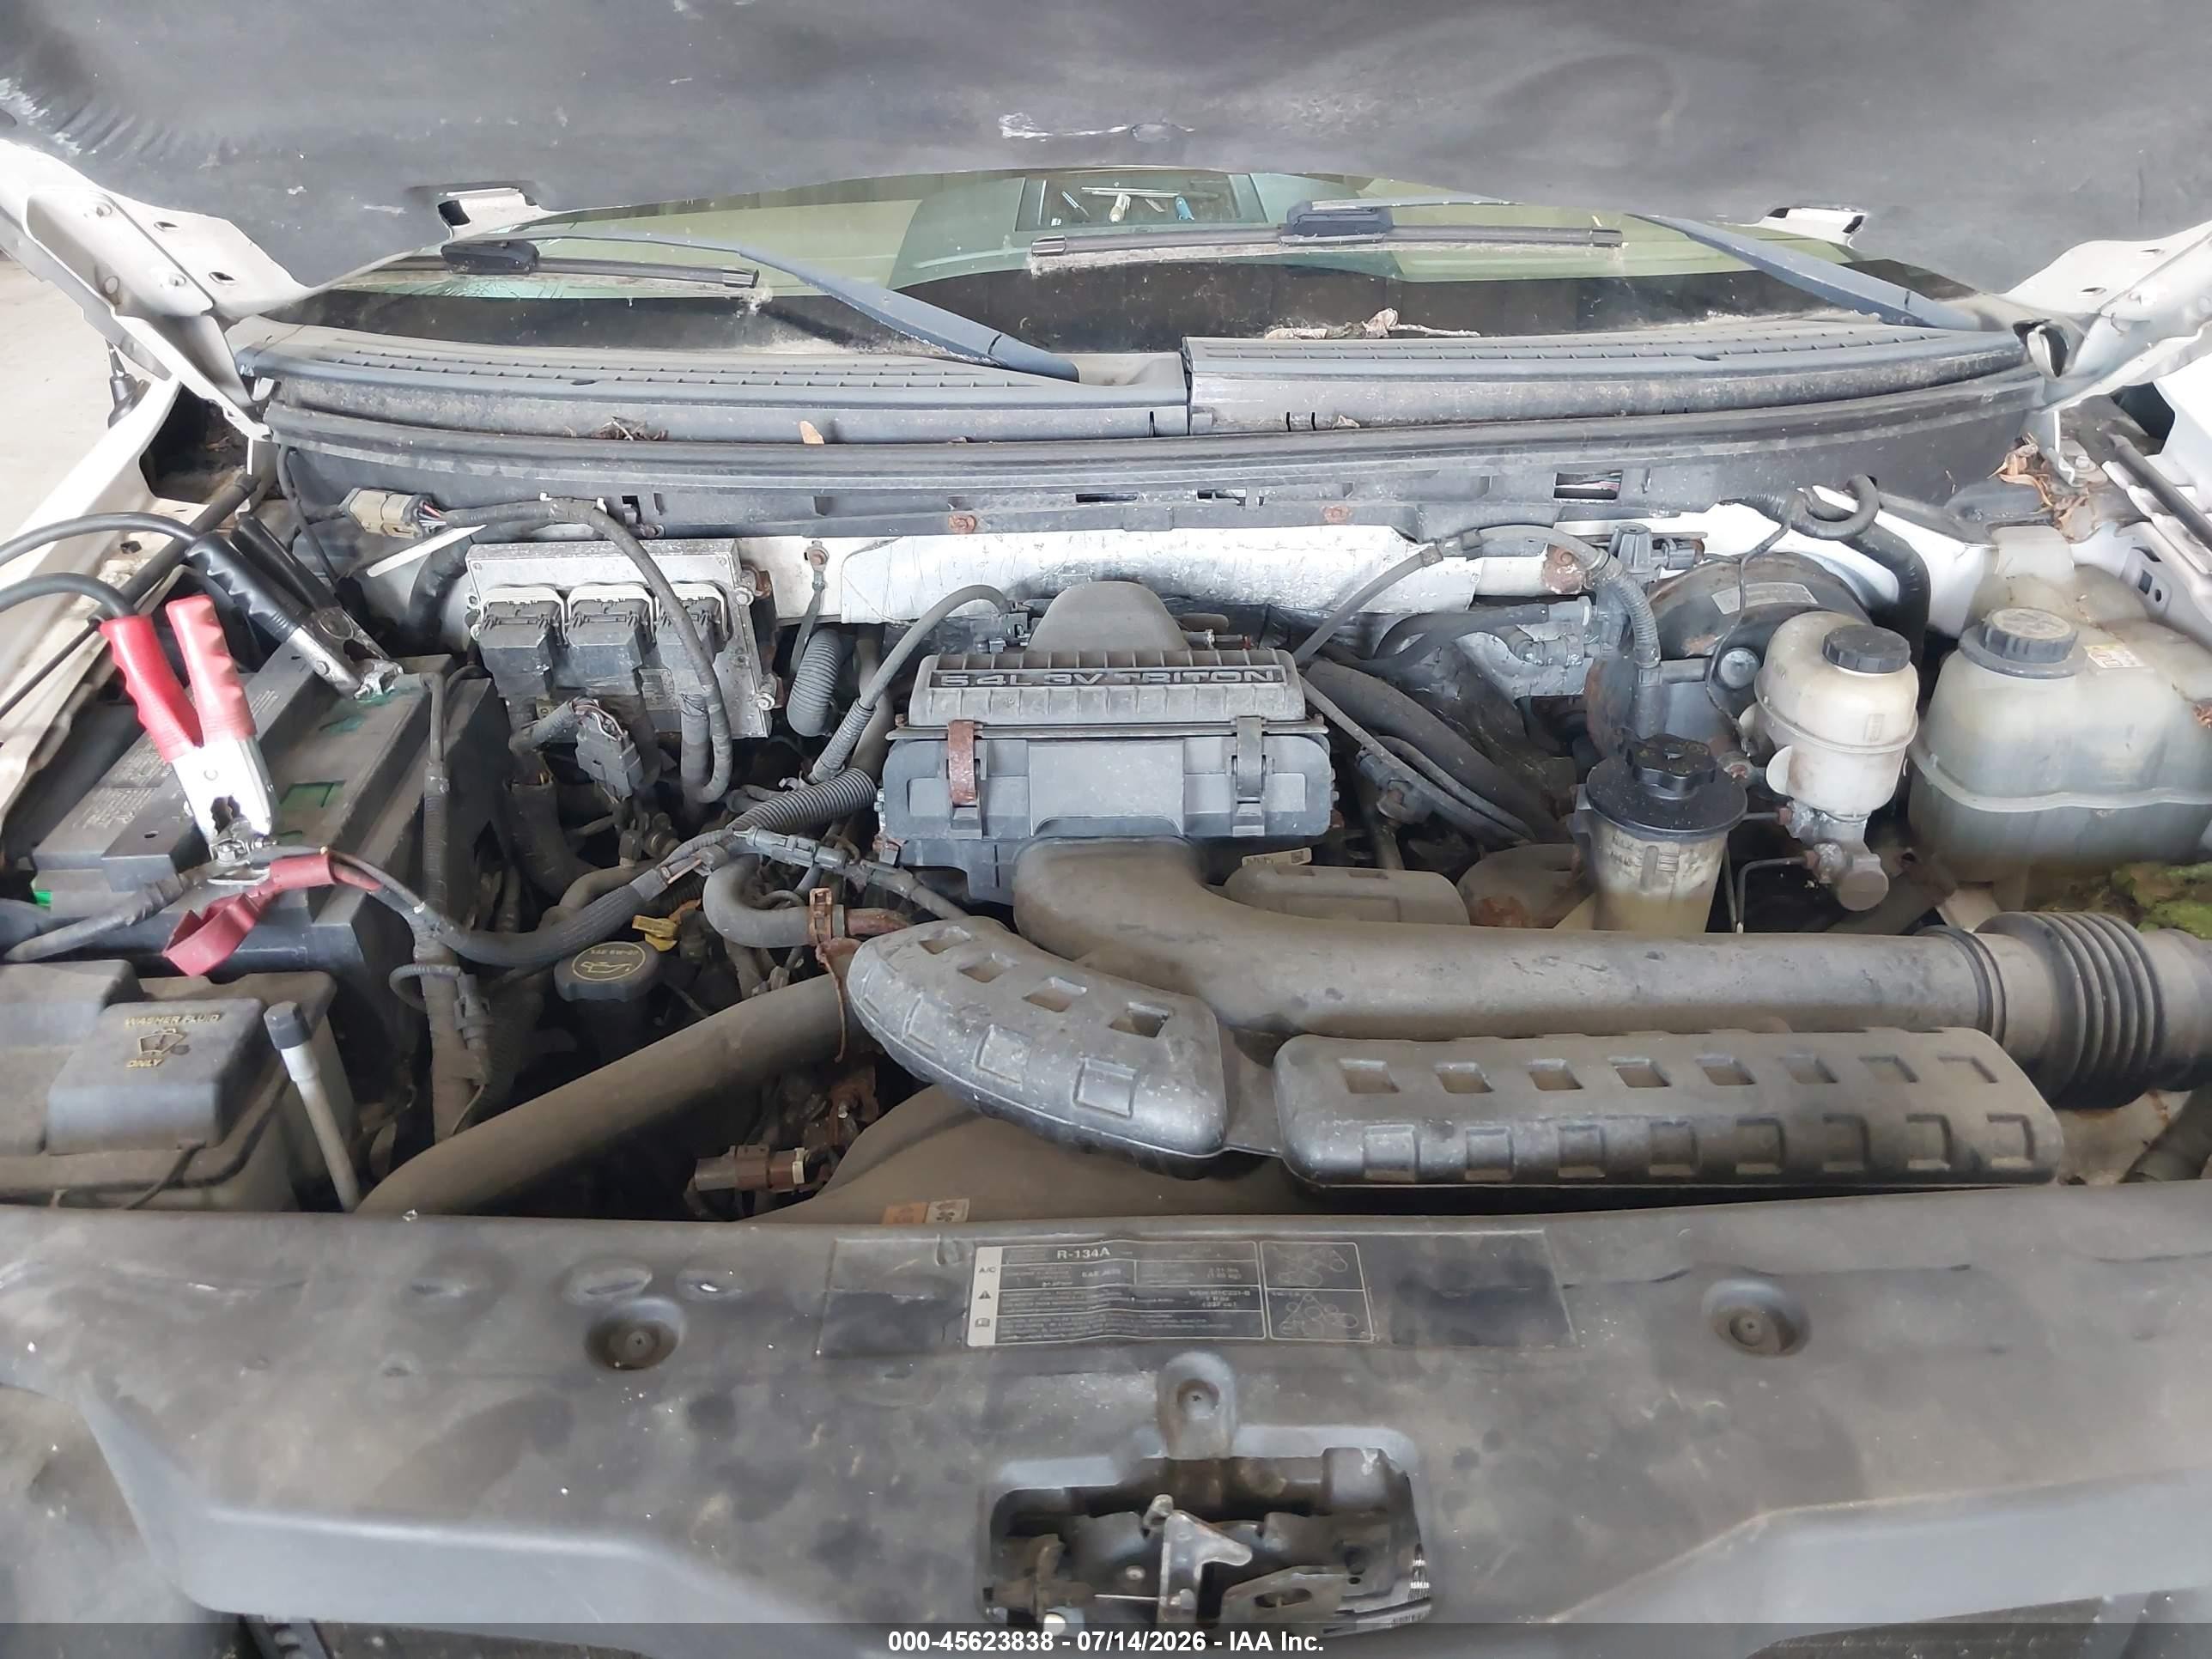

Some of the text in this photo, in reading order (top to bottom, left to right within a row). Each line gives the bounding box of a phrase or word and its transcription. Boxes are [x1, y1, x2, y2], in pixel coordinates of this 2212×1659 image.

[940, 670, 1274, 687] 5.4L 3V TRITON
[124, 1014, 222, 1029] WASHER FLUID
[125, 1057, 164, 1068] ONLY
[1056, 1247, 1110, 1260] R-134A
